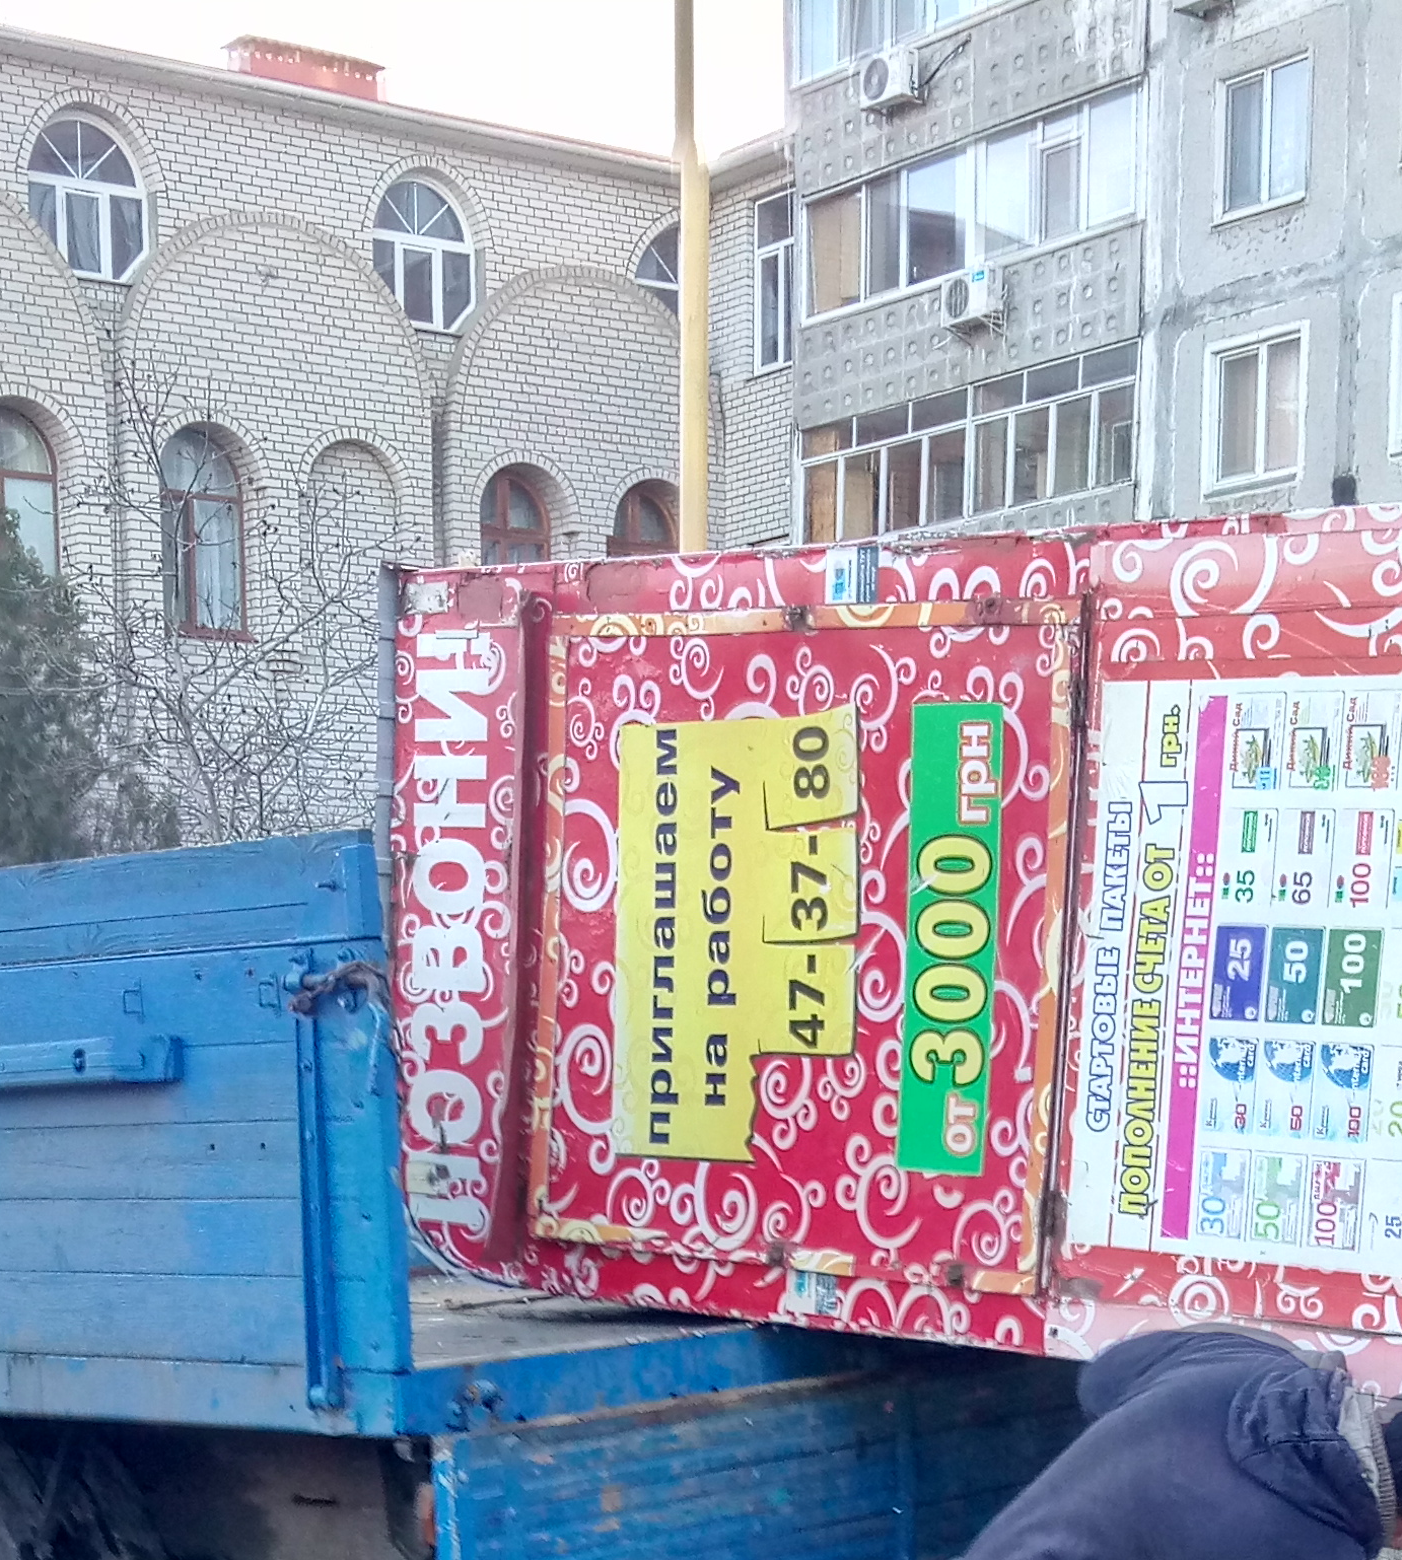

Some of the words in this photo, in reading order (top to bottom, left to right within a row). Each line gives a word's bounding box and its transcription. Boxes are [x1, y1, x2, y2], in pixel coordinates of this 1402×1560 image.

[1160, 703, 1182, 769] грн.
[959, 722, 997, 825] грн
[1137, 780, 1189, 825] 1
[703, 765, 740, 1005] работу
[1100, 800, 1133, 932] ПАКЕТЫ
[1143, 843, 1175, 892] ОТ
[1234, 869, 1256, 904] 35
[1291, 871, 1313, 905] 65
[1350, 862, 1372, 908] 100
[409, 632, 491, 1224] ПОЗВОНИ!
[643, 727, 679, 1146] приглашаем
[1130, 896, 1172, 993] СЧЕТА
[909, 834, 992, 1085] 3000
[1227, 938, 1252, 980] 25
[1284, 940, 1310, 984] 50
[1339, 932, 1366, 995] 100
[1087, 947, 1120, 1132] СТАРТОВЫЕ
[702, 1032, 730, 1107] на
[947, 1094, 977, 1157] от
[1119, 999, 1161, 1215] ПОПОЛНЕНИЕ
[1234, 1103, 1248, 1131] 30
[1290, 1105, 1304, 1132] 50
[1347, 1106, 1363, 1138] 100
[1199, 1196, 1227, 1234] 30
[1253, 1200, 1282, 1240] 50
[1313, 1202, 1339, 1246] 100
[1384, 1214, 1402, 1240] 25
